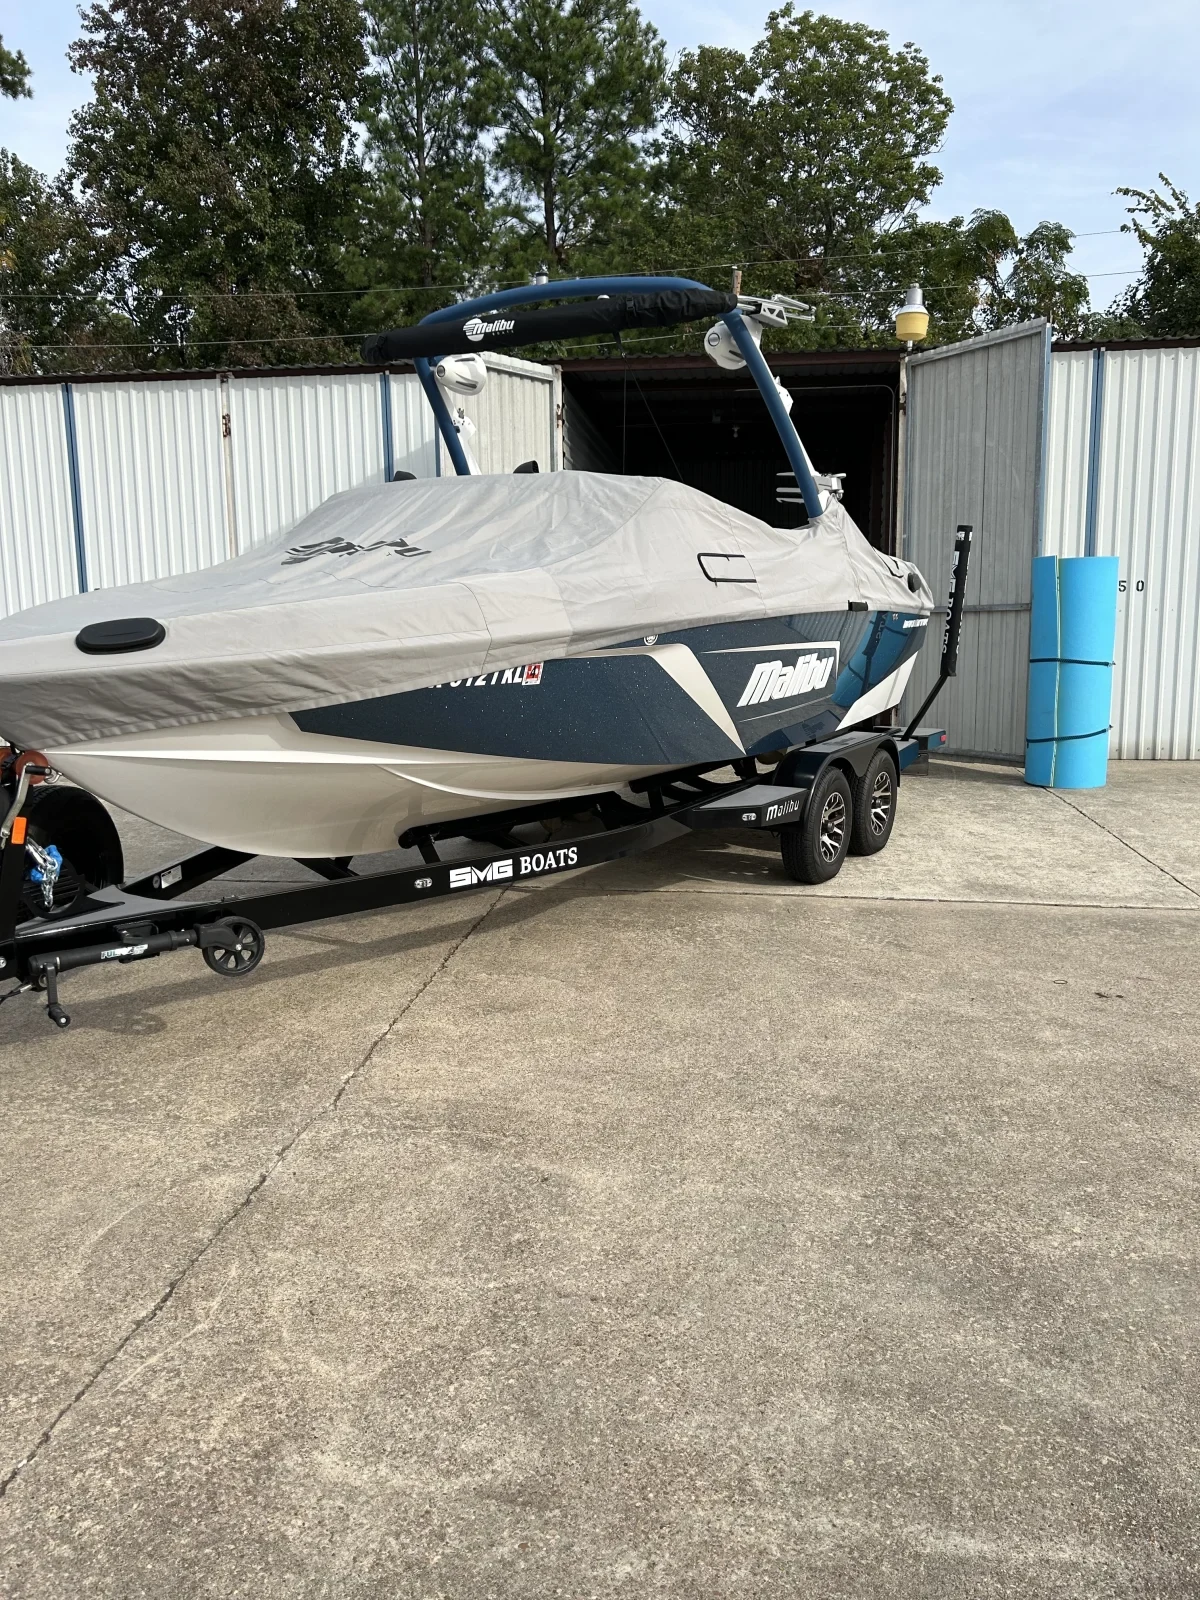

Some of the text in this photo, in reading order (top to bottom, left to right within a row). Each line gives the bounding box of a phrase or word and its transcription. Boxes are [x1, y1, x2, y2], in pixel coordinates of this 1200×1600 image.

[473, 319, 515, 335] Malibu
[736, 653, 834, 707] Malibu
[766, 799, 800, 821] Malibu
[450, 847, 578, 889] SMG BOATS
